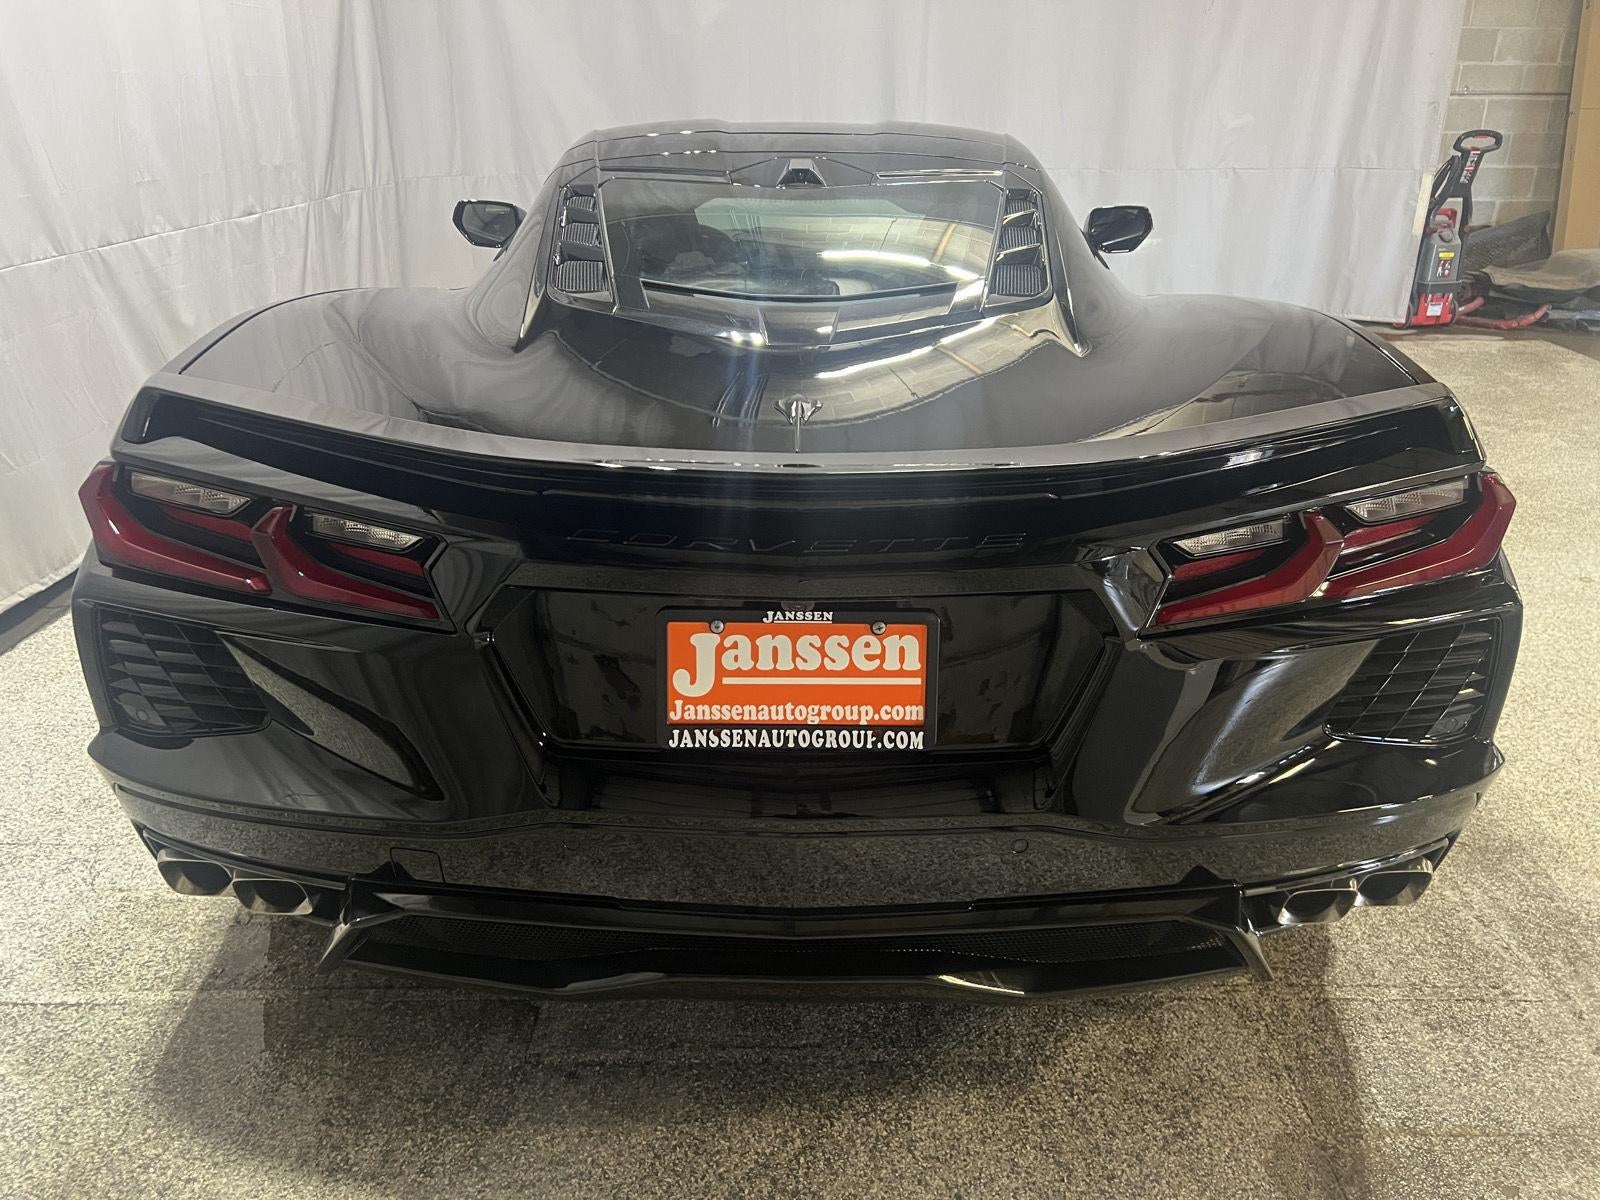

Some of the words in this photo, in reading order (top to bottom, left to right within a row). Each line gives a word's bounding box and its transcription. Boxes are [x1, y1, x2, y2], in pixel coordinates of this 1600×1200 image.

[565, 529, 1027, 553] CORVETTE
[762, 610, 833, 624] JANSSEN
[672, 632, 922, 697] Janssen
[669, 699, 925, 725] Janssenautogroup.com
[668, 728, 925, 750] JANSSENAUTOGROUP.COM
